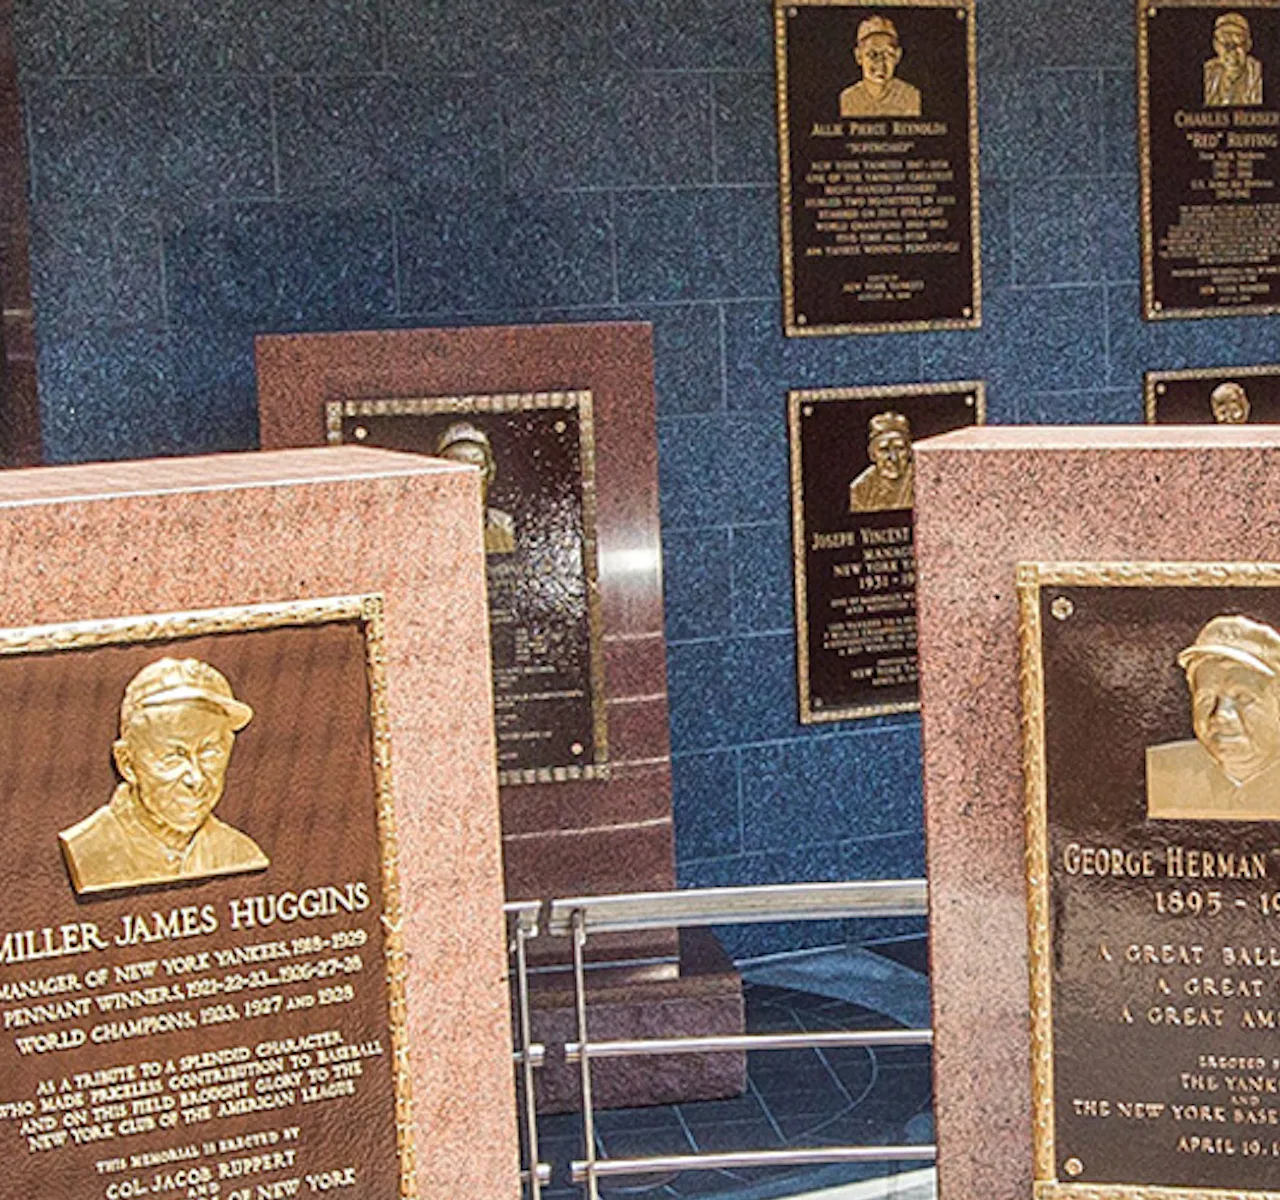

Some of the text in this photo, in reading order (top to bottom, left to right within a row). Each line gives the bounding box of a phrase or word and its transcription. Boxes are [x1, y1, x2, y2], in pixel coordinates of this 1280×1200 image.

[1064, 843, 1155, 878] GEORGE
[1167, 846, 1266, 880] HERMAN
[114, 904, 219, 947] JAMES
[229, 881, 370, 930] HUGGINS
[1155, 889, 1222, 917] 1895
[1098, 943, 1113, 961] A
[1125, 944, 1205, 965] GREAT
[85, 967, 109, 989] OF
[114, 960, 158, 985] NEW
[162, 951, 210, 977] YORK
[1157, 976, 1171, 995] A
[1184, 977, 1263, 998] GREAT
[3, 996, 93, 1029] PENNANT
[15, 1028, 87, 1055] WORLD
[244, 995, 284, 1018] 1927
[286, 994, 315, 1011] AND
[318, 984, 355, 1006] 1928
[1119, 1005, 1133, 1024] A
[1147, 1006, 1224, 1027] GREAT
[1198, 1055, 1266, 1070] ERECTED
[59, 1078, 72, 1093] A
[139, 1061, 163, 1079] TO
[164, 1060, 176, 1074] A
[1180, 1072, 1220, 1091] THE
[27, 1078, 356, 1155] NEW YORK CLUB OF THE AMERICAN LEAGUE
[1072, 1098, 1111, 1117] THE
[1117, 1101, 1165, 1120] NEW
[1171, 1104, 1226, 1123] YORK
[1177, 1136, 1235, 1156] APRIL
[152, 1167, 212, 1193] JACOB
[219, 1150, 297, 1180] RUPPERT
[305, 1166, 357, 1193] YORK
[188, 1181, 221, 1199] AND
